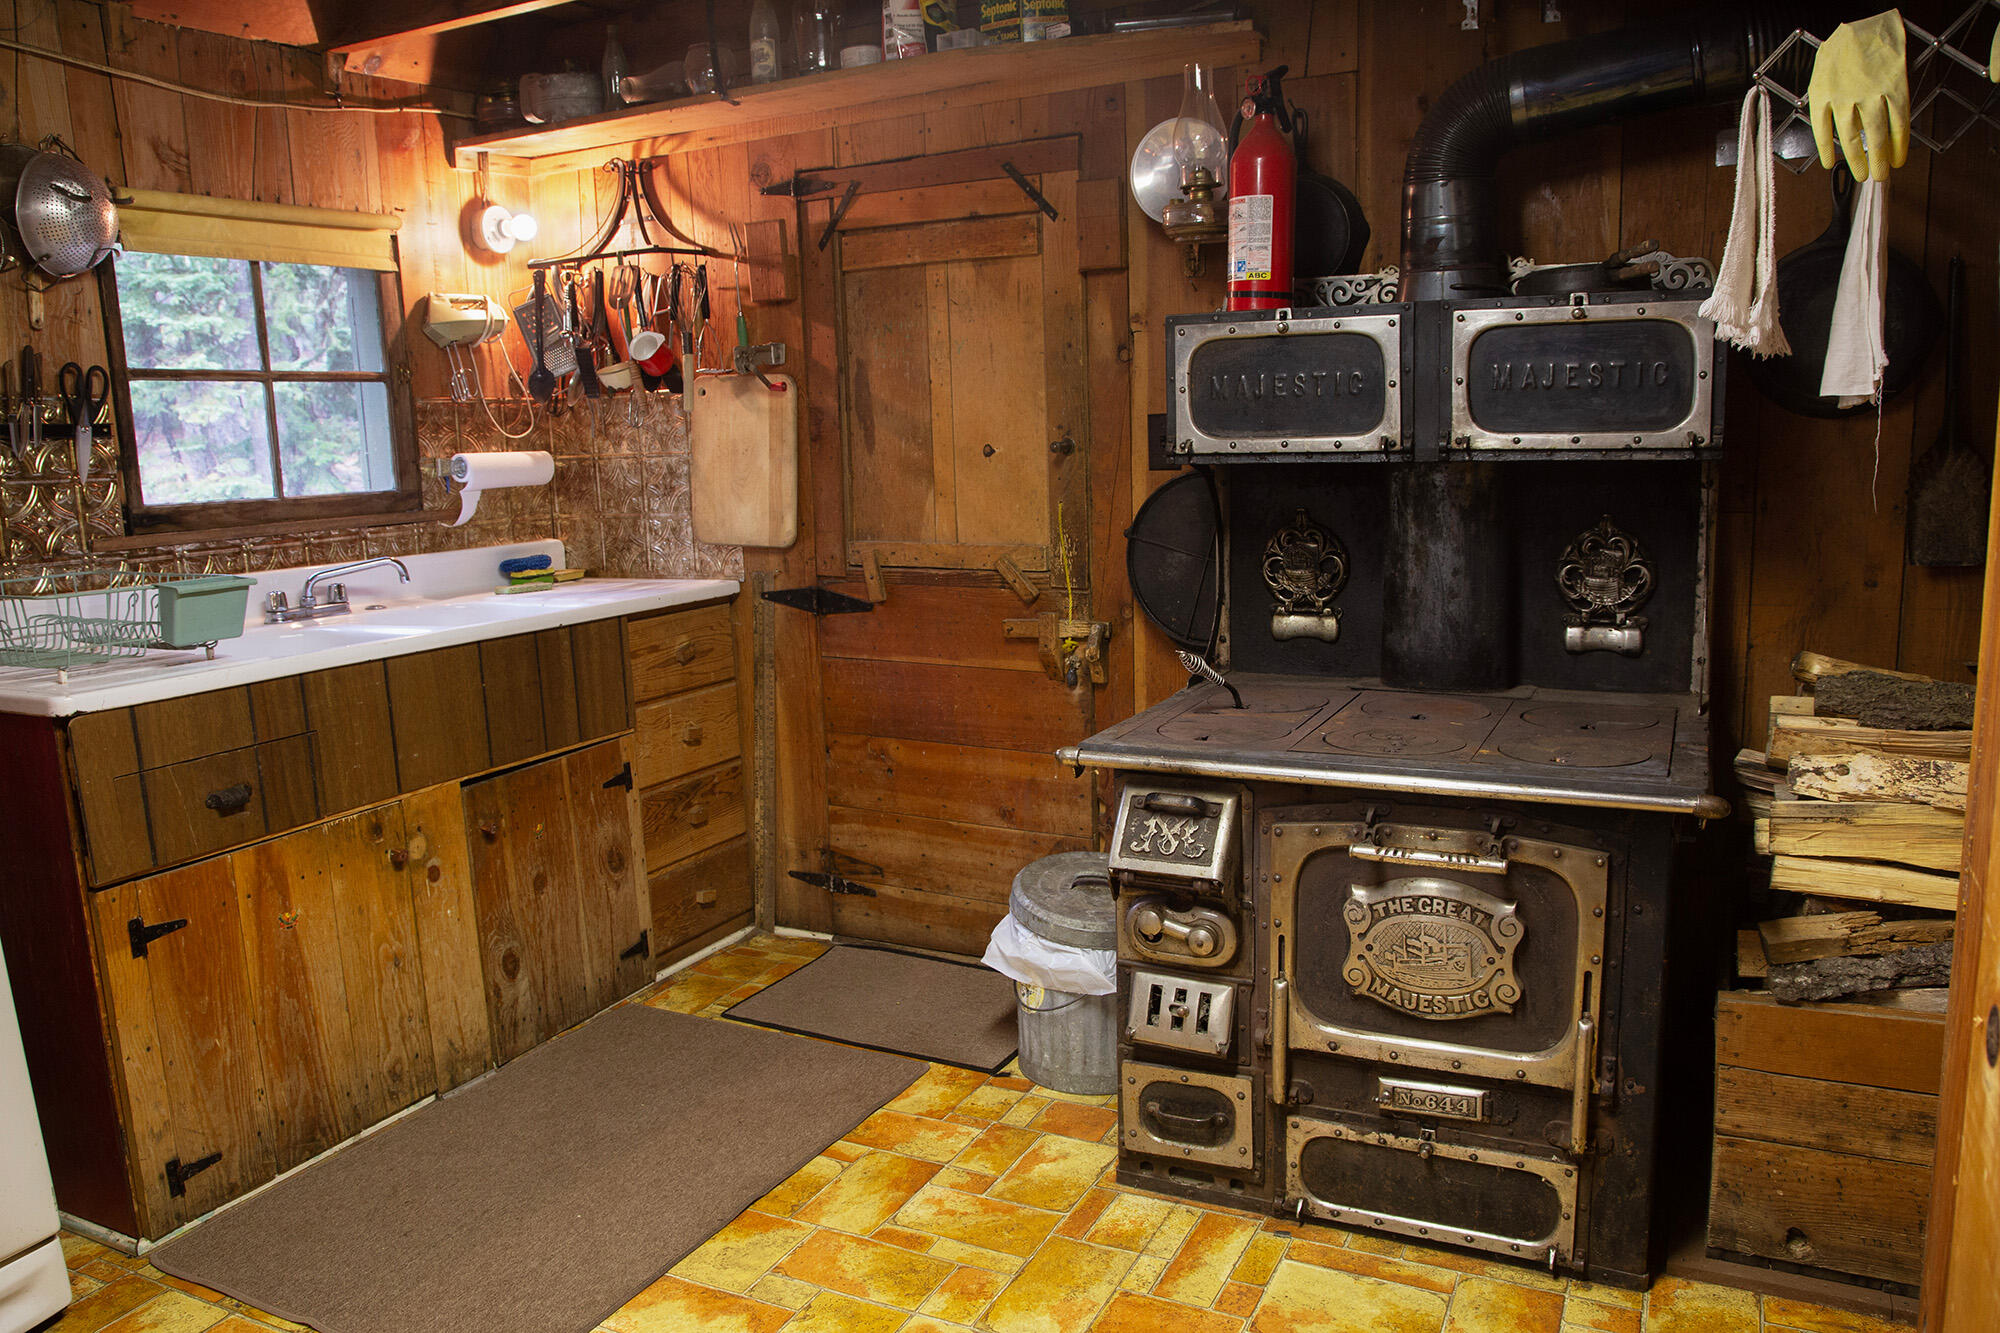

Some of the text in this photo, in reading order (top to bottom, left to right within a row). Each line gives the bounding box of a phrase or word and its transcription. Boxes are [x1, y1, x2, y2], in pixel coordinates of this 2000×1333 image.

[981, 0, 1017, 24] Septonic
[1209, 371, 1363, 400] MAJESTIC
[1492, 361, 1669, 391] MAJESTIC
[1372, 897, 1490, 927] THE GREAT
[1370, 977, 1489, 1013] MAJESTIC
